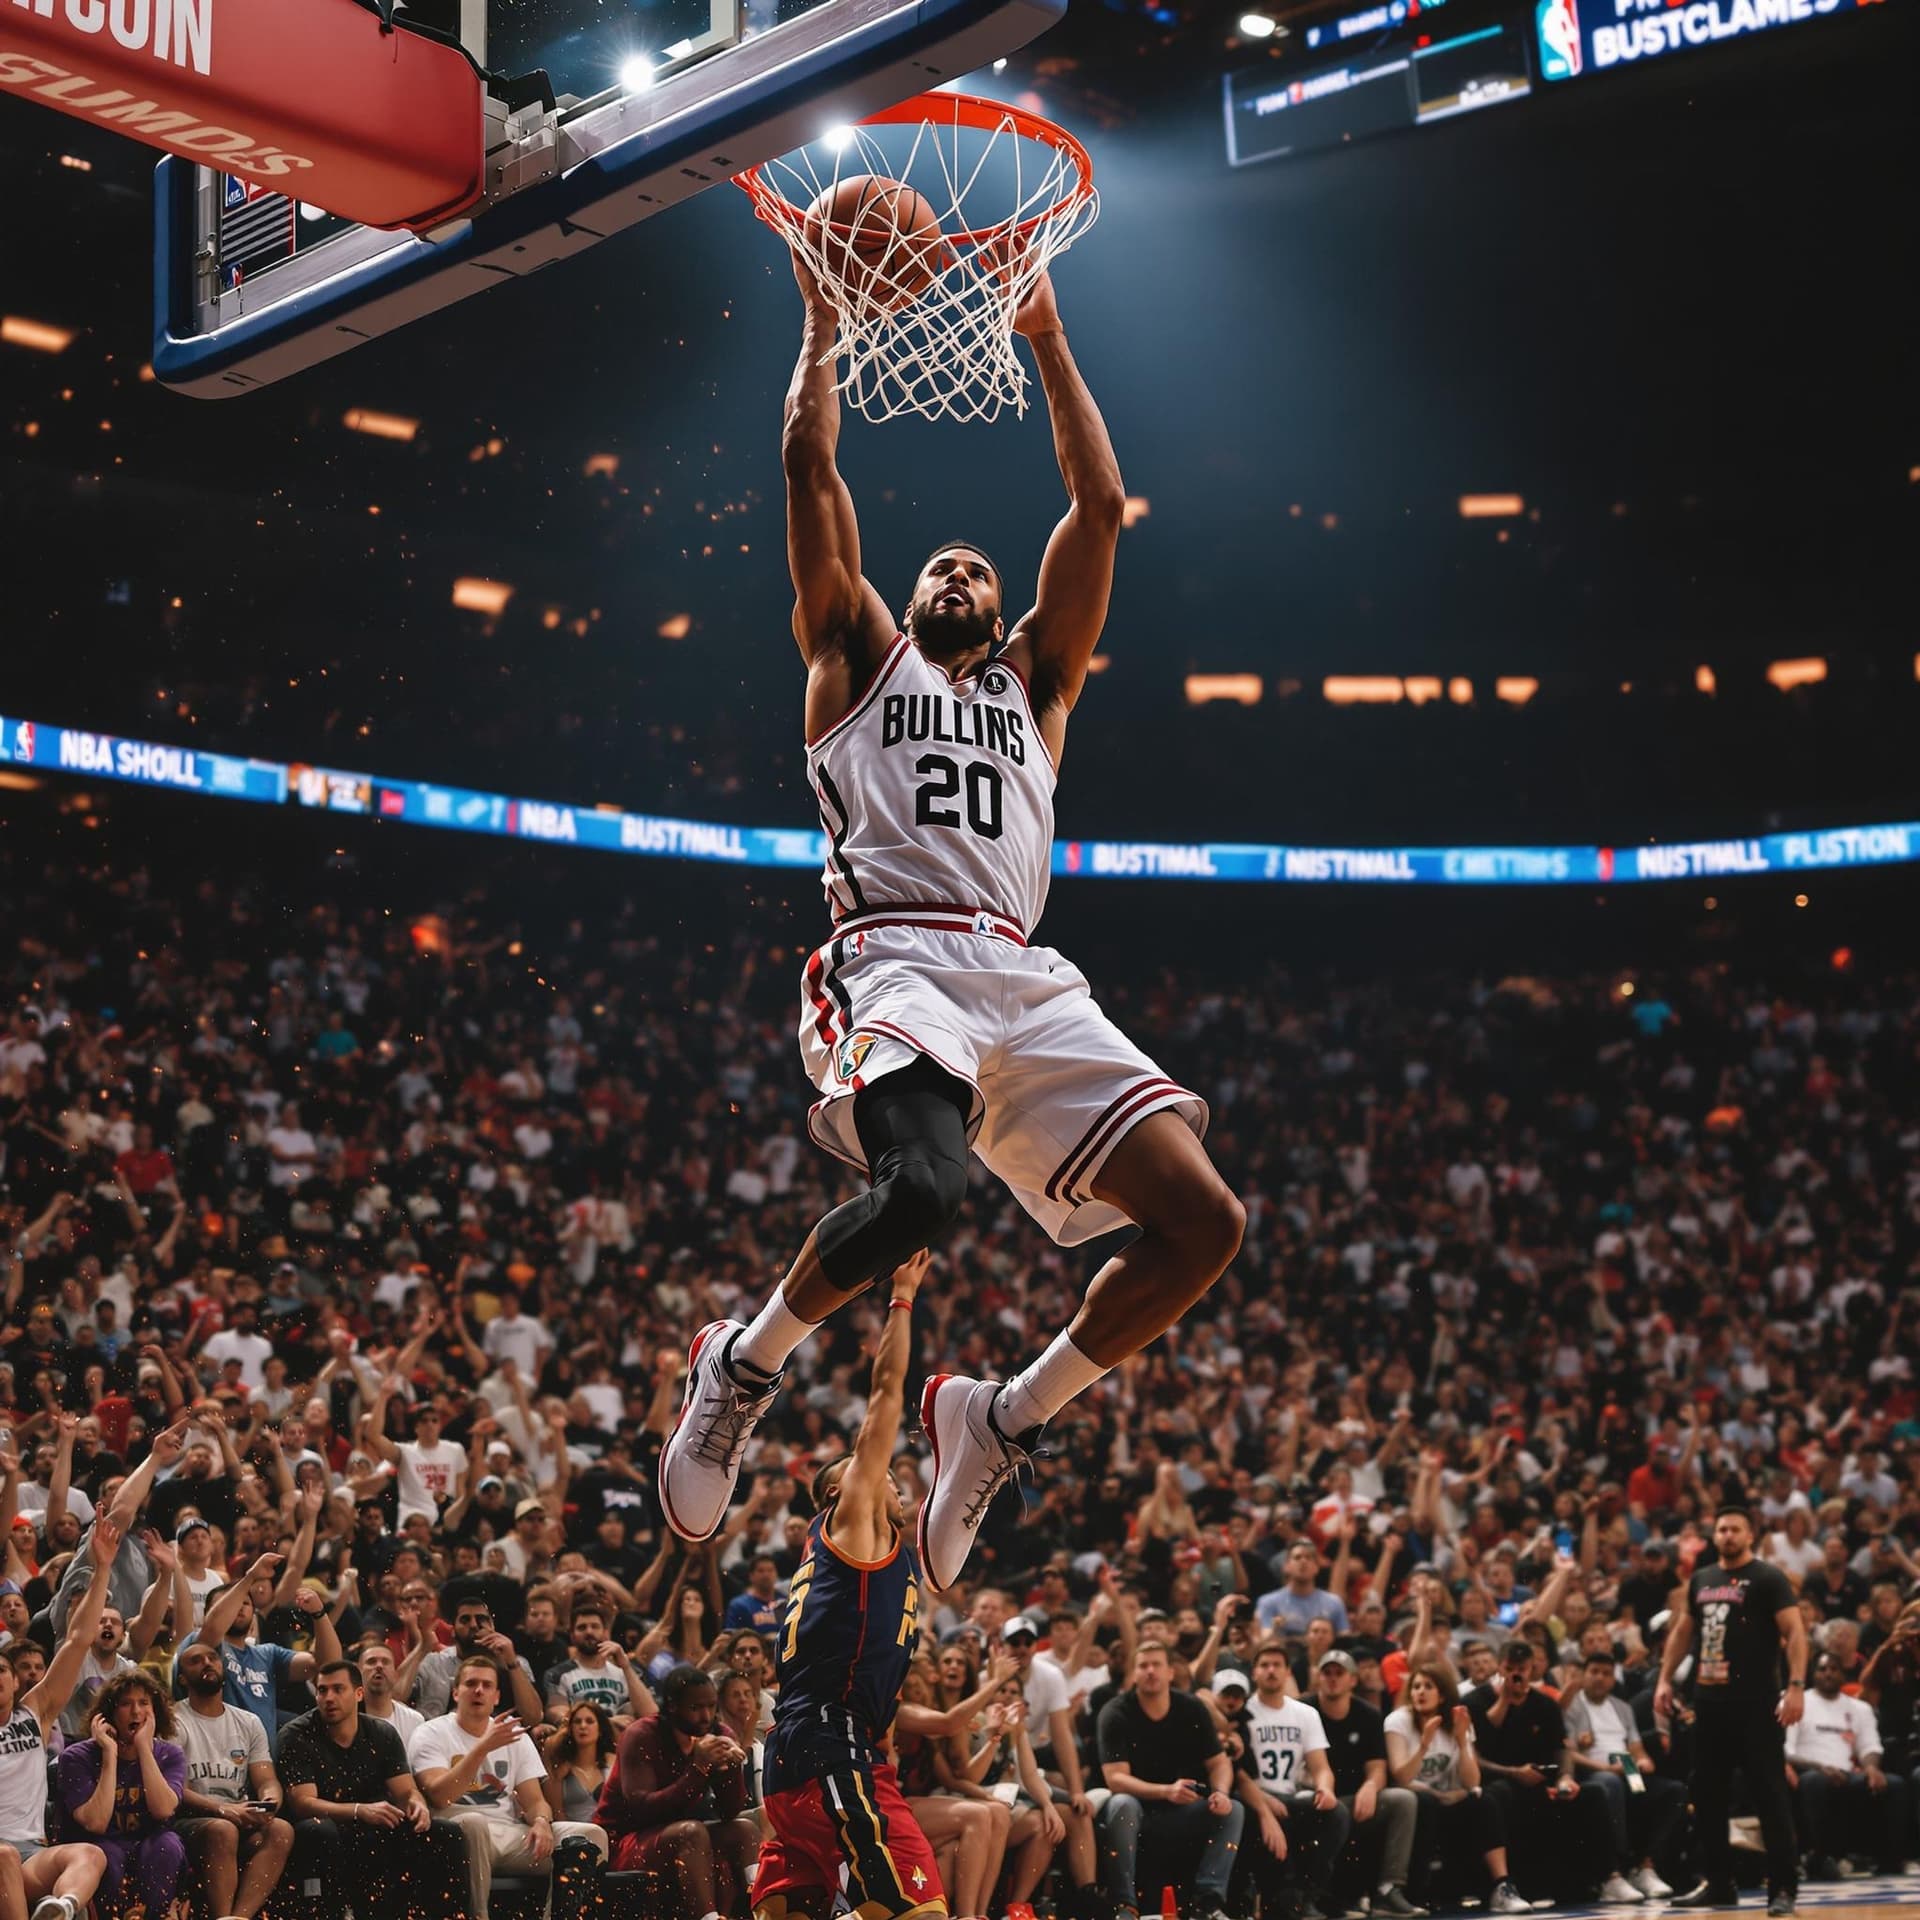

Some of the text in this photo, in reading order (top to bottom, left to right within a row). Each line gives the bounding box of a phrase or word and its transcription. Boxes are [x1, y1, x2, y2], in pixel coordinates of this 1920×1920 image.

[60, 729, 115, 773] NBA
[883, 694, 1025, 767] BULLINS
[915, 753, 1003, 841] 20
[521, 801, 577, 842] NBA
[1261, 1749, 1294, 1780] 37
